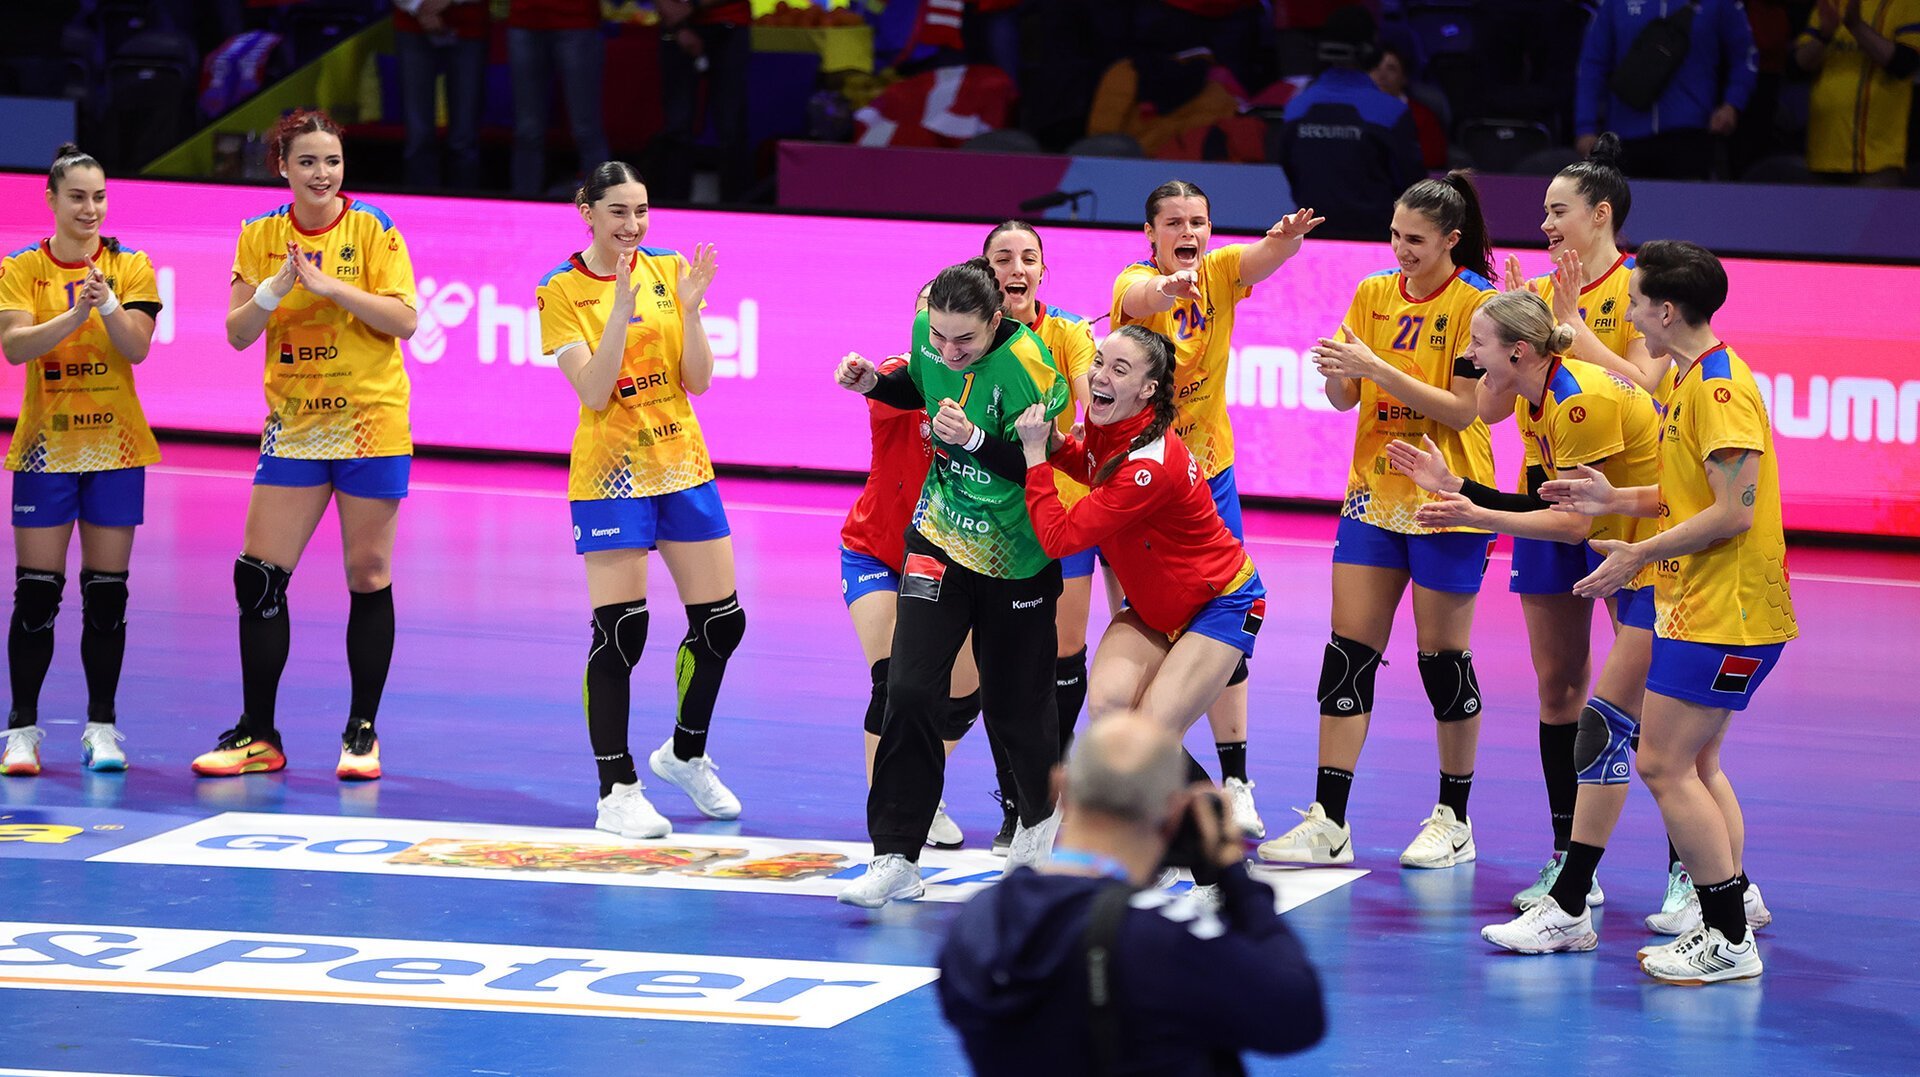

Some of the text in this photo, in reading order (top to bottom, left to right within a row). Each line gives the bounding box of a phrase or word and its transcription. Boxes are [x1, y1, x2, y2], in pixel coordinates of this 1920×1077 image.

[1298, 124, 1361, 140] SECURITY
[1173, 304, 1207, 341] 24
[1393, 314, 1425, 350] 27
[299, 346, 339, 361] BRD
[66, 363, 109, 376] BRD
[958, 371, 977, 409] 1
[304, 396, 347, 410] NIRO
[73, 412, 115, 425] NIRO
[591, 527, 621, 537] Kempa
[858, 570, 889, 584] Kempa
[1012, 597, 1044, 610] Kempa
[196, 833, 414, 855] GO
[0, 931, 880, 1004] & Peter
